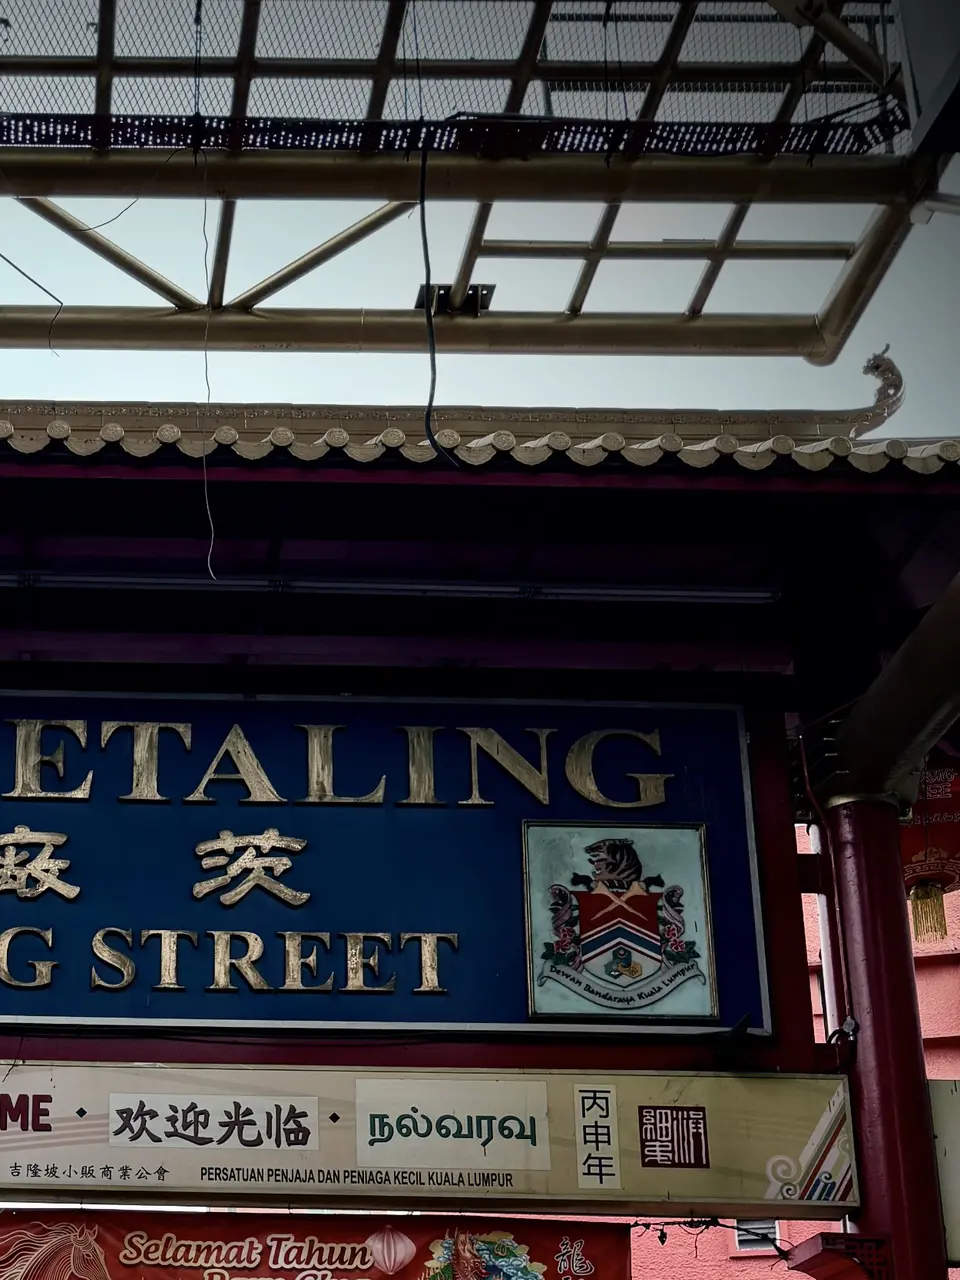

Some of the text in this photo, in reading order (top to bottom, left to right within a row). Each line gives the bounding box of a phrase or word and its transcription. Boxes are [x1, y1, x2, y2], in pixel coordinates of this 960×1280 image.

[89, 927, 459, 995] STREET
[548, 962, 697, 1006] Dewan Bandaraya Kuala Lumpur
[111, 1099, 313, 1148] 欢迎光临
[367, 1106, 538, 1148] நல்வரவு
[578, 1089, 617, 1186] 丙申年
[8, 1162, 171, 1181] 吉隆坡小販商業公會
[200, 1167, 514, 1188] PERSATUAN PENJAJA DAN PENIAGA KECIL KUALA LUMPUR
[119, 1231, 375, 1270] Selamat Tahun
